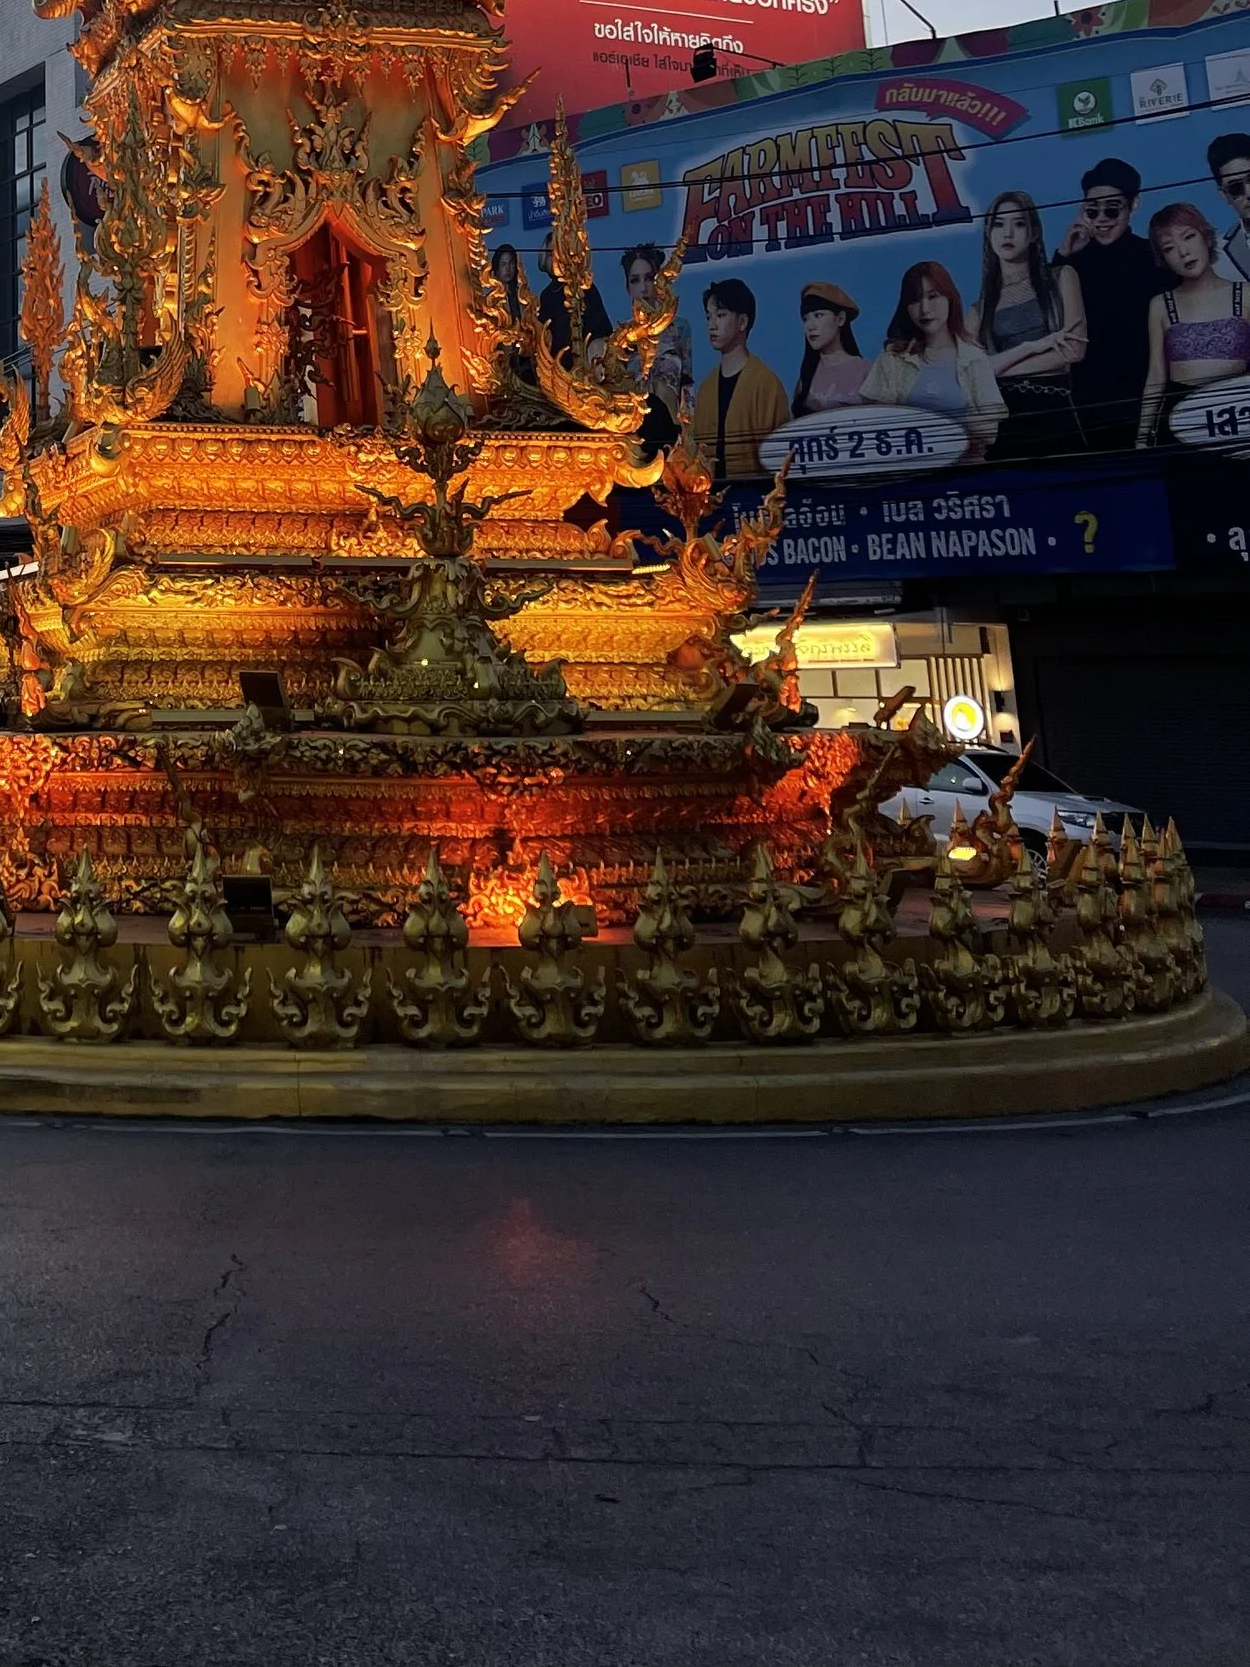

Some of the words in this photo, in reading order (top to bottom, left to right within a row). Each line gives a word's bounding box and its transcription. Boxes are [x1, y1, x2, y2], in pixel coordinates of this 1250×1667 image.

[885, 82, 1007, 126] กลับมาแล้ว!!!
[1068, 113, 1104, 129] KBank
[1138, 93, 1183, 109] RIVERIE
[682, 119, 973, 264] FARMFEST
[706, 210, 755, 262] ON
[760, 194, 834, 252] THE
[835, 190, 933, 241] HILL
[848, 430, 866, 459] 2
[876, 428, 934, 457] ธ.ค.
[783, 536, 847, 565] BACON
[867, 531, 927, 561] BEAN
[931, 527, 1037, 559] NAPASON
[1074, 510, 1098, 553] ?
